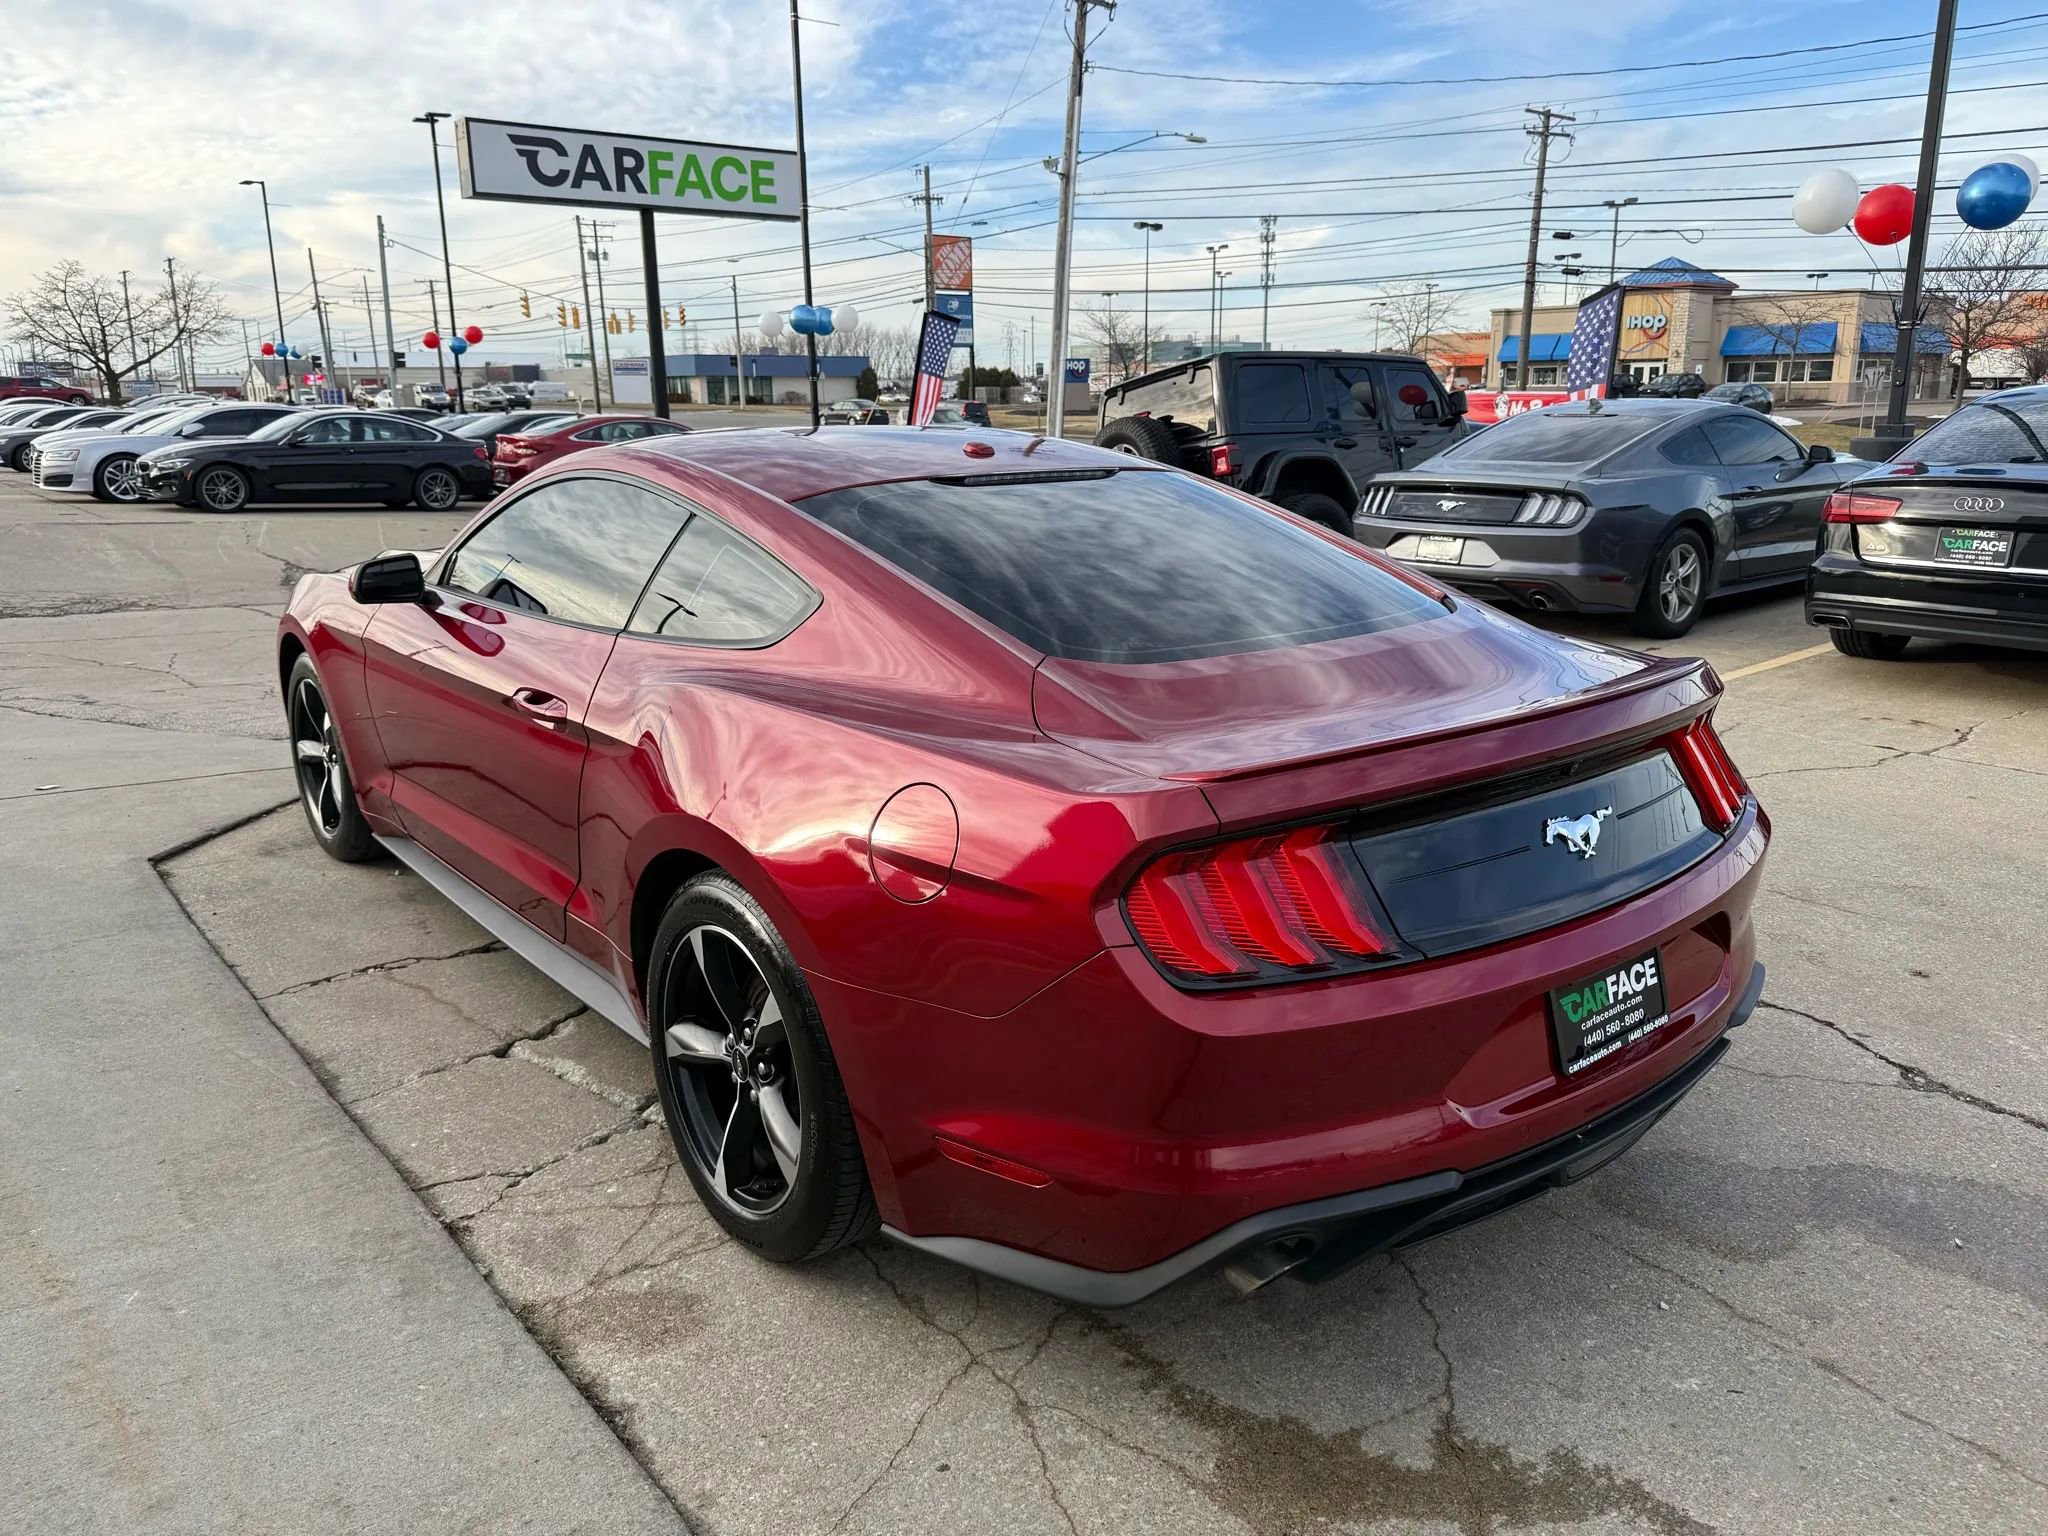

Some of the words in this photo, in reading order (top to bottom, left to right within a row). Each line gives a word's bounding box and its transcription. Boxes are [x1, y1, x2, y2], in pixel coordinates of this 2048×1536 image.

[507, 133, 777, 205] CARFACE
[1626, 314, 1667, 333] IHOP
[1066, 360, 1085, 373] HOP
[1956, 529, 1996, 538] CARFACE
[1942, 537, 2008, 552] CARFACE
[1560, 957, 1658, 1022] CARFACE
[1581, 995, 1643, 1030] carfaceauto.com
[1584, 1028, 1605, 1047] (440)
[1568, 1040, 1622, 1074] carfaceauto.com
[1627, 1029, 1643, 1043] (440)
